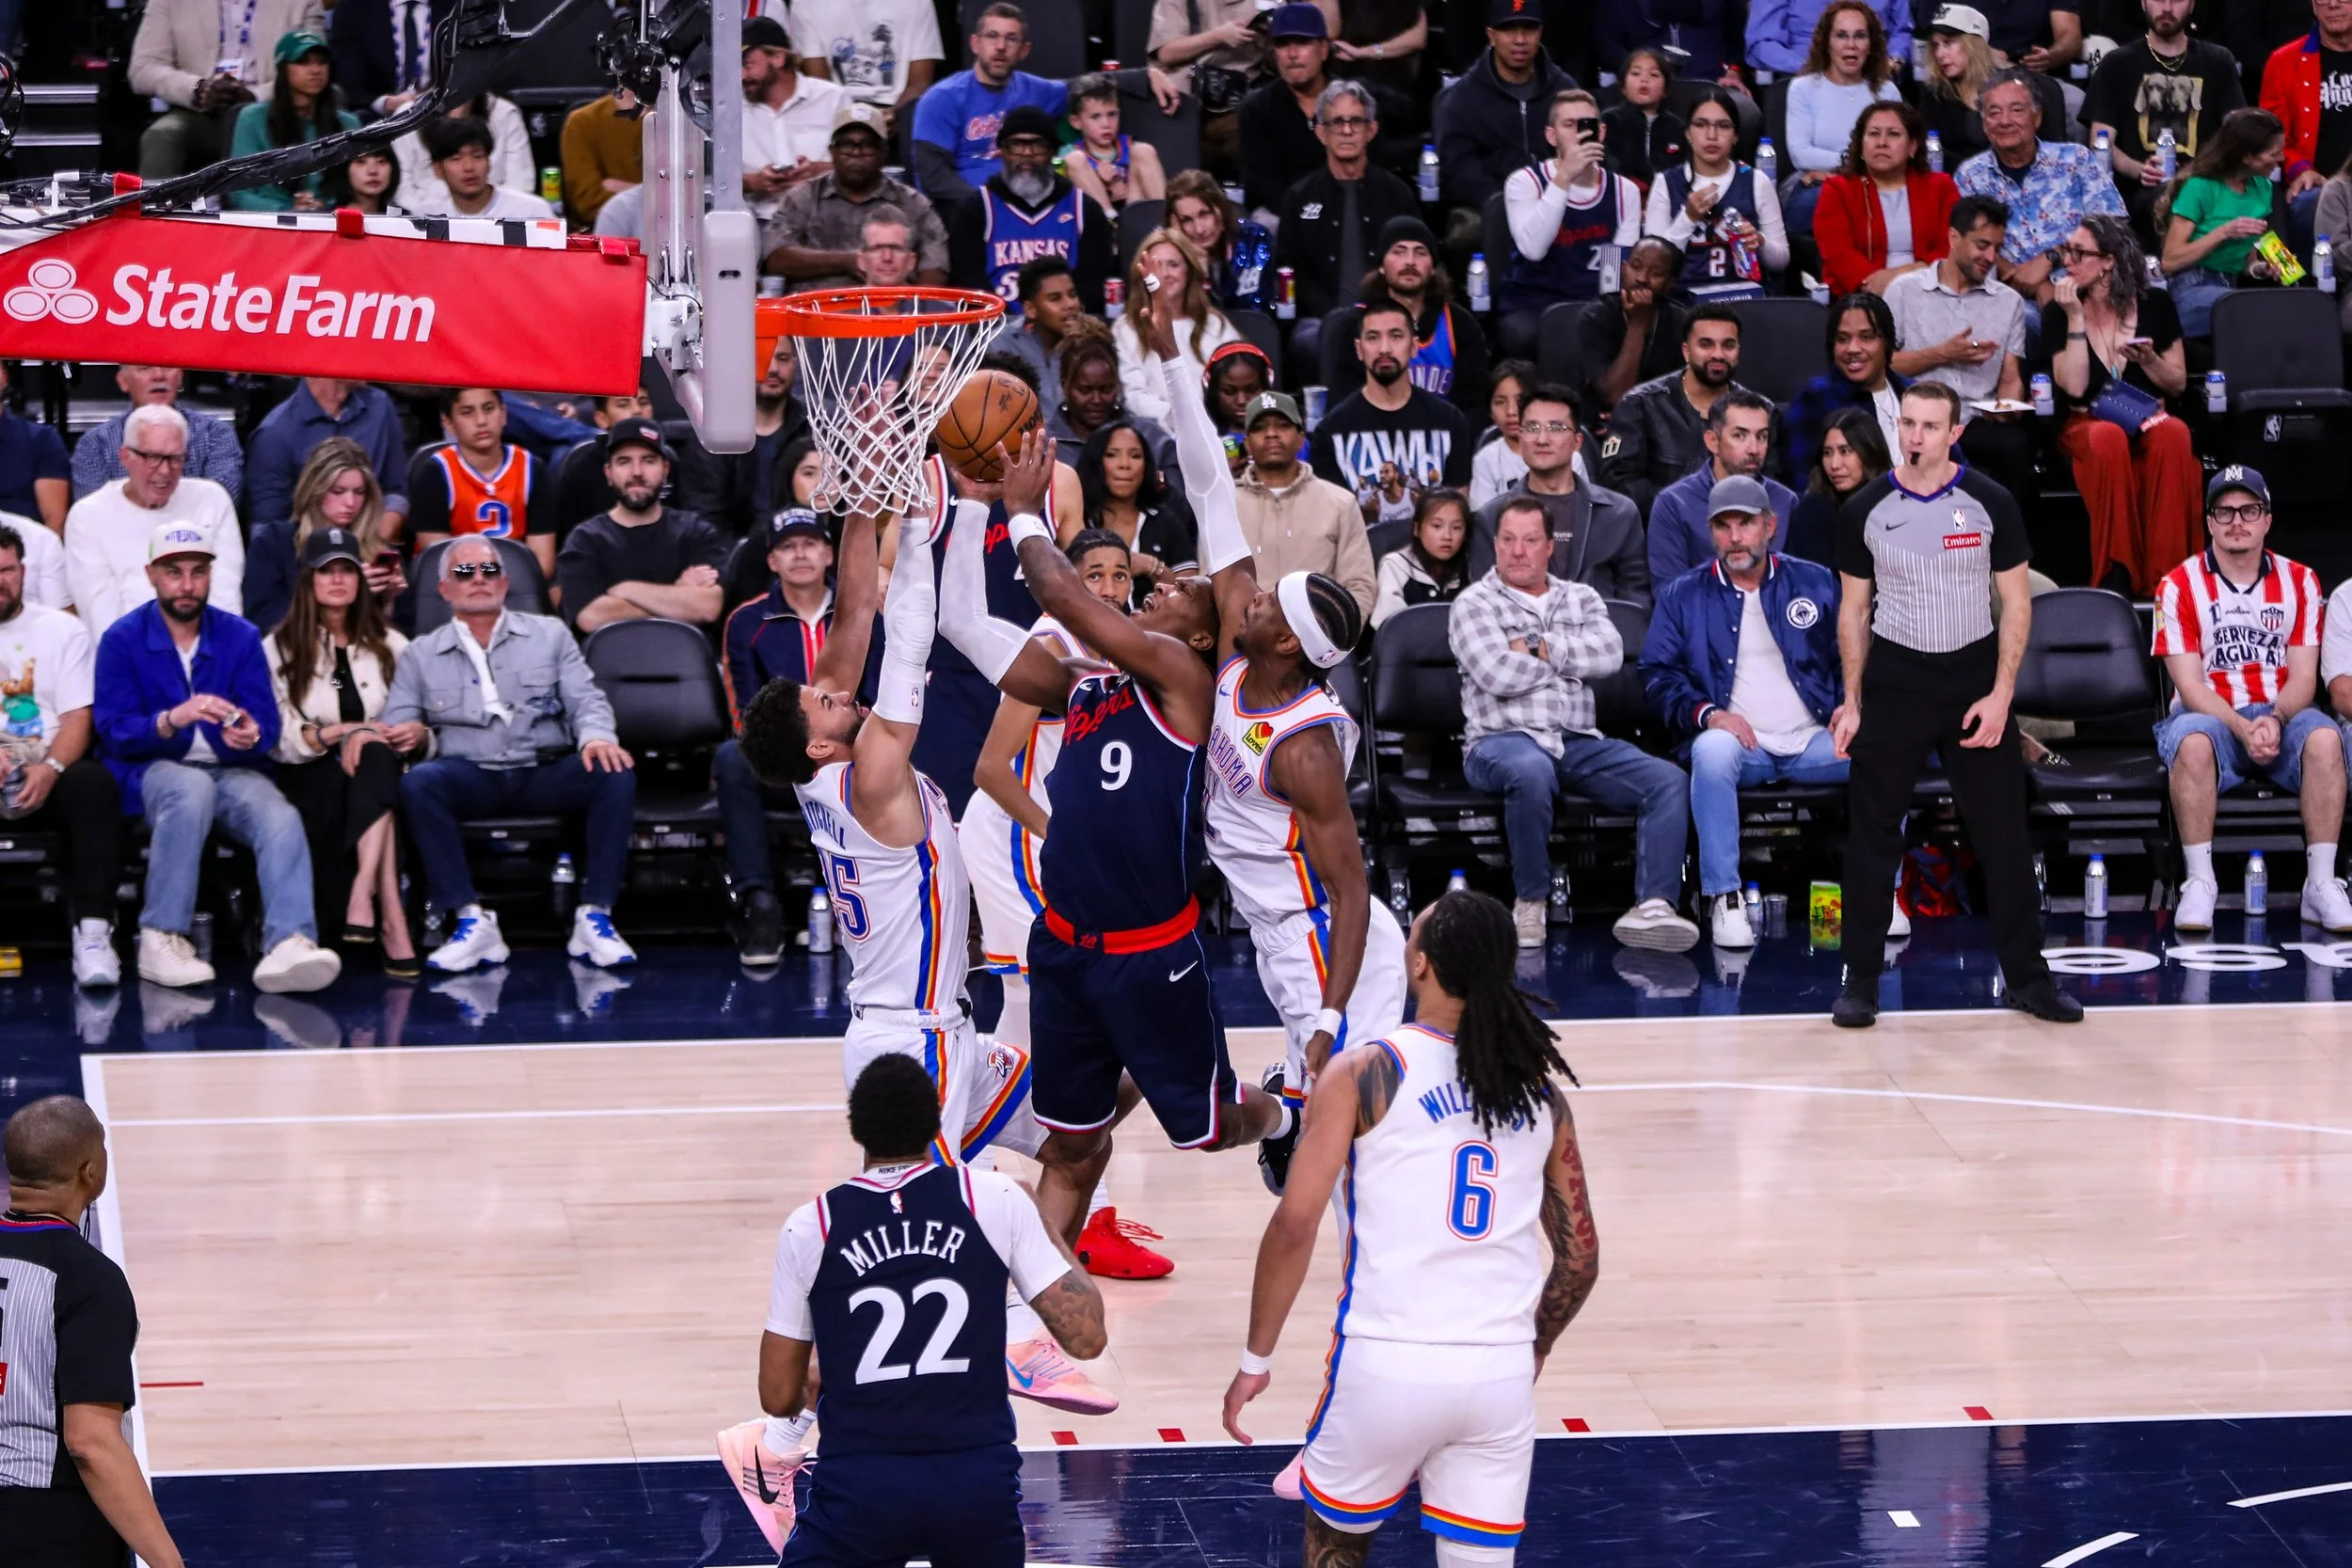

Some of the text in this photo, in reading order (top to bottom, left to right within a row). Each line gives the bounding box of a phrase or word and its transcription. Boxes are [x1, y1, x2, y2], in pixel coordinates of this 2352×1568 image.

[1944, 536, 1981, 547] Emirates
[1101, 740, 1132, 790] 9
[1207, 725, 1254, 798] AHOMA
[1446, 1140, 1499, 1242] 6
[839, 1220, 966, 1277] MILLER
[849, 1277, 971, 1385] 22
